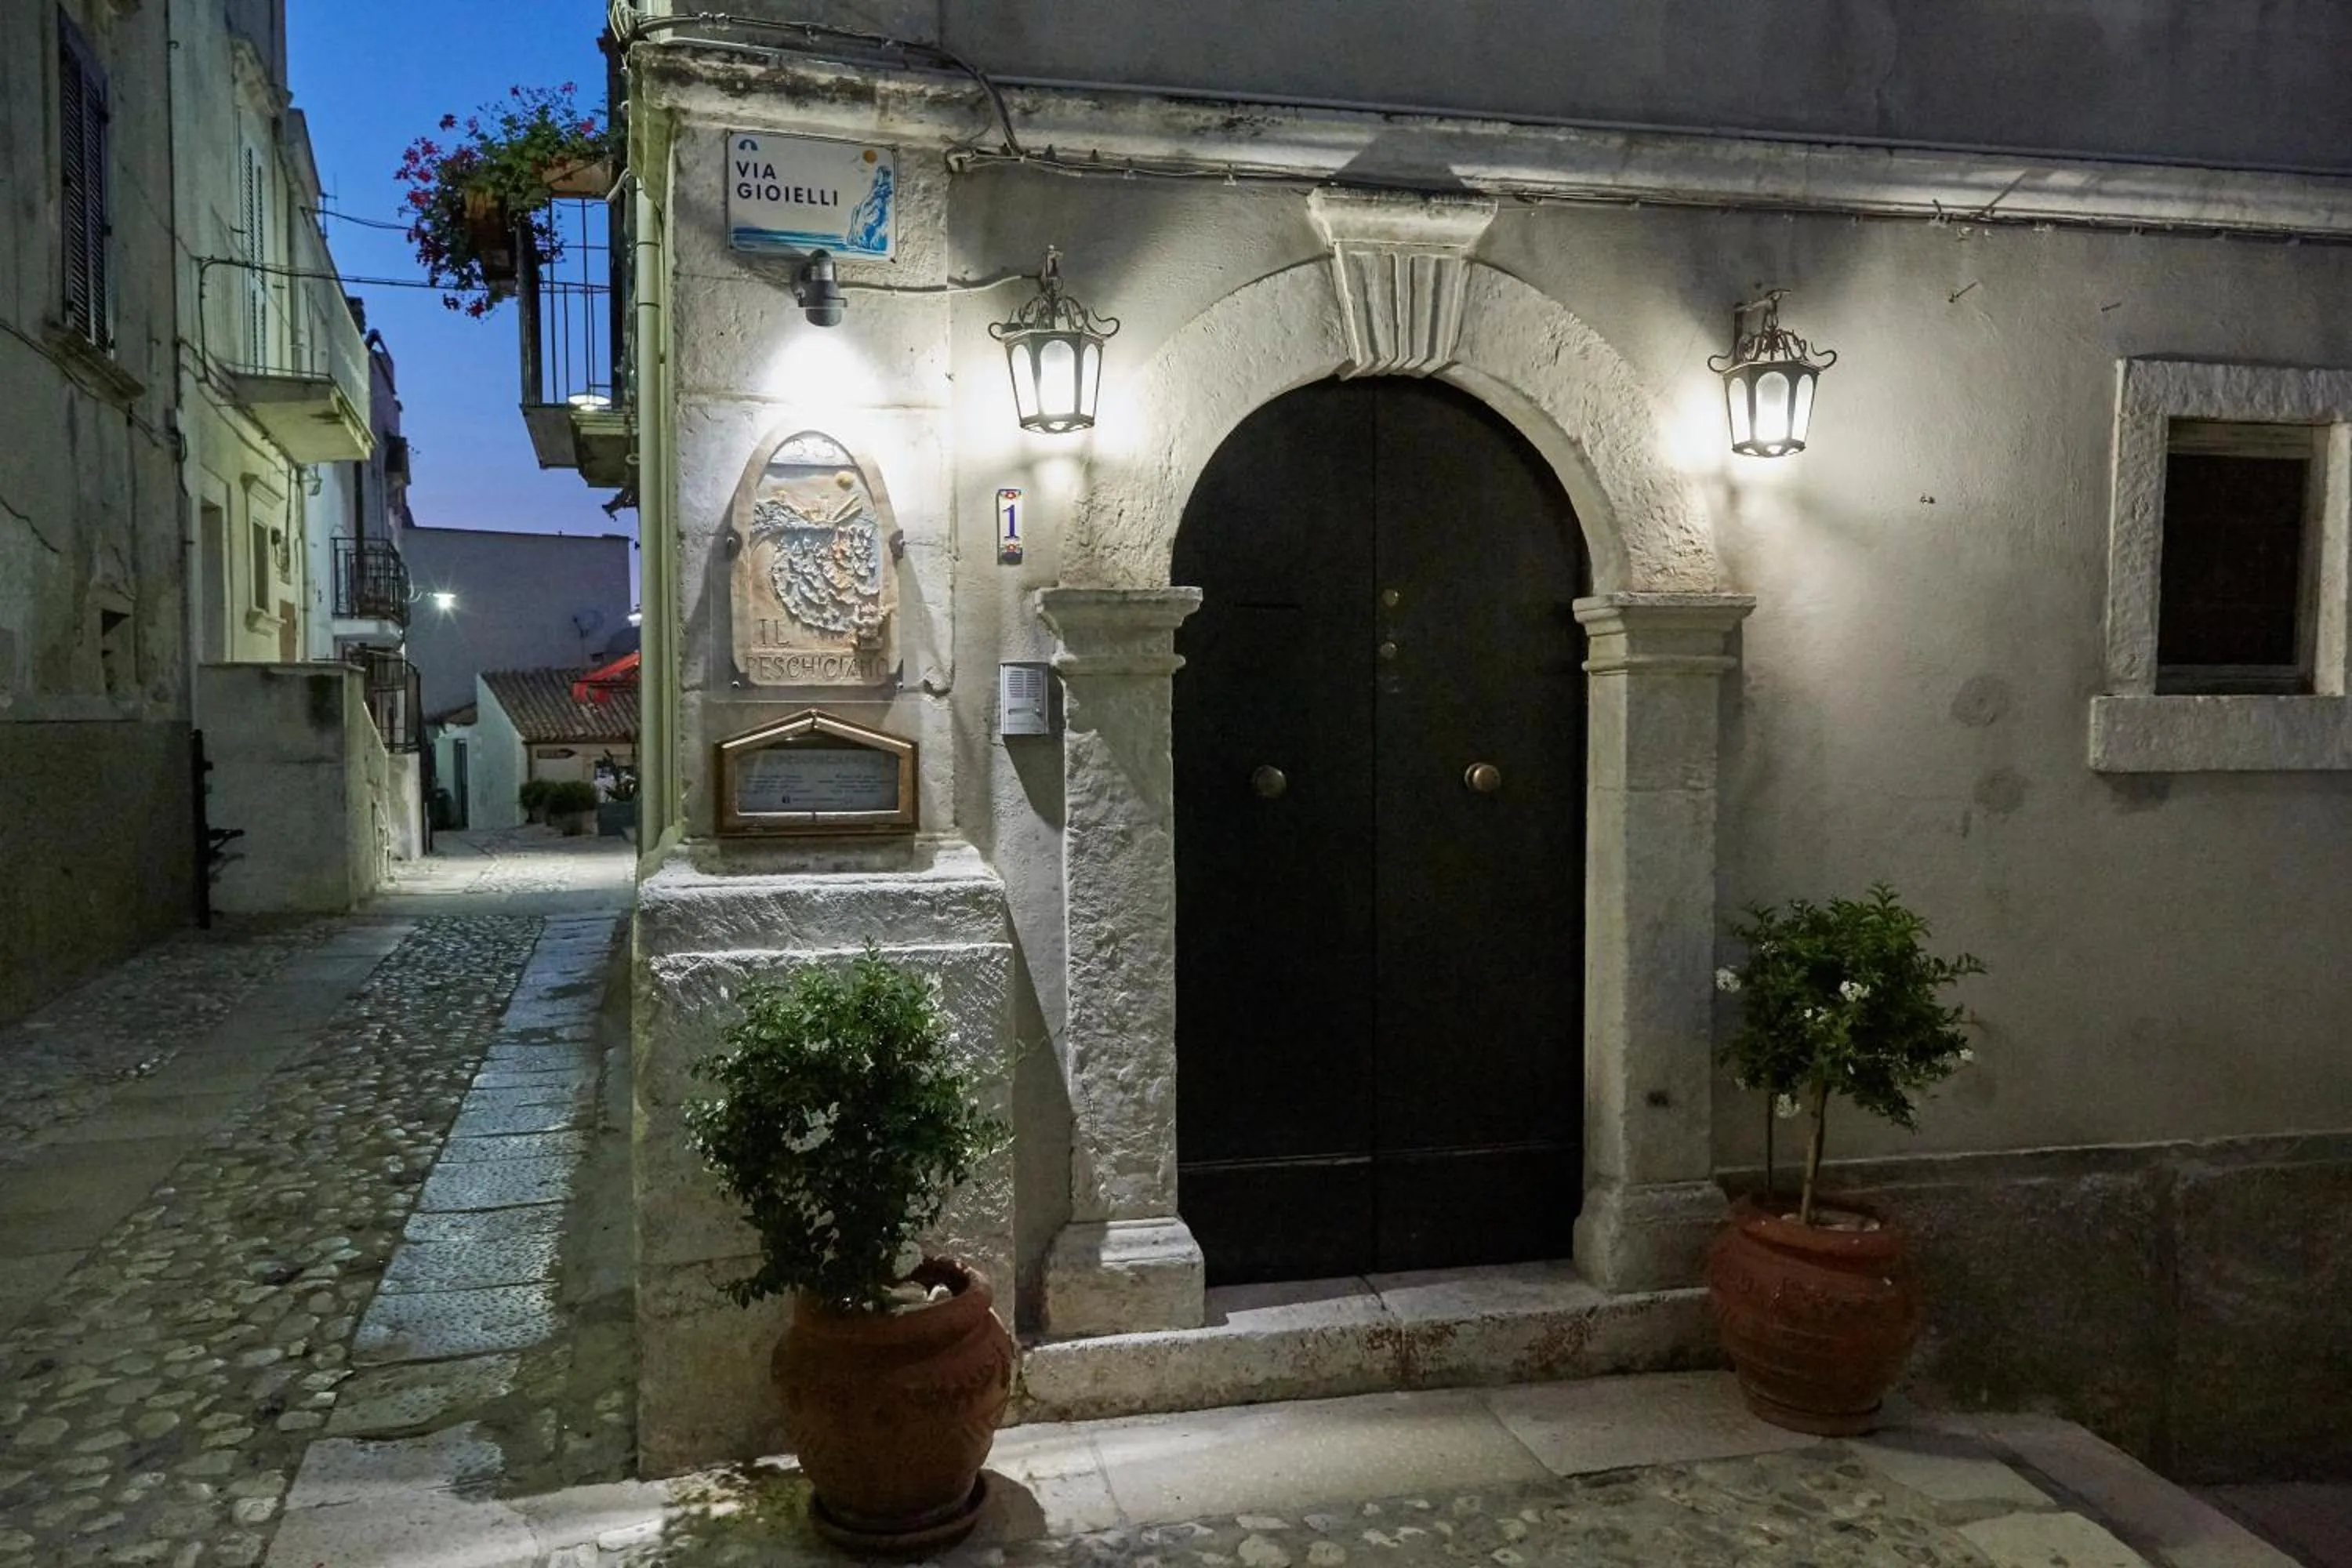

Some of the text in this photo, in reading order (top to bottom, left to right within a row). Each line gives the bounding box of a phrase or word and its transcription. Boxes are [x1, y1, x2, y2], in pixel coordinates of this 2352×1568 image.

[736, 161, 776, 180] VIA
[737, 183, 838, 206] GIOIELLI
[1003, 504, 1019, 539] 1
[758, 619, 789, 645] IL
